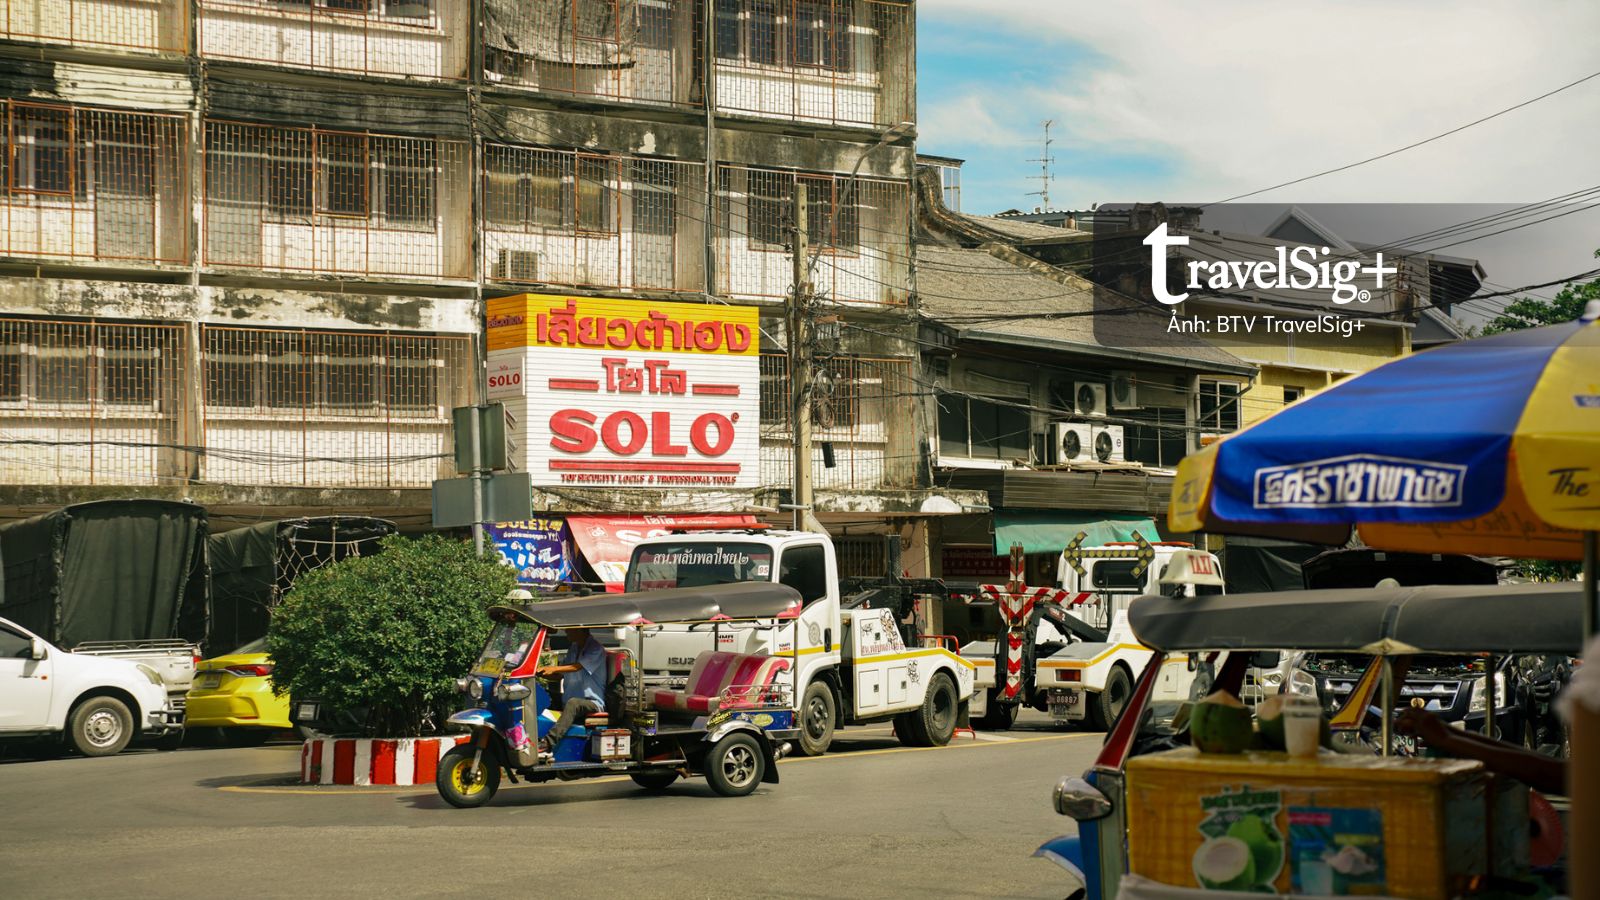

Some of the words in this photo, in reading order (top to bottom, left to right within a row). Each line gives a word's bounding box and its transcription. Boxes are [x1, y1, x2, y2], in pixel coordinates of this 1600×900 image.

[537, 300, 751, 350] เลี่ยวต้าเฮง
[489, 373, 521, 388] SOLO
[602, 358, 687, 393] โซโล
[577, 474, 616, 484] SECURITY
[618, 474, 644, 485] LOCKS
[656, 474, 711, 485] PROFESSIONAL
[712, 475, 737, 485] TOOLS
[1188, 555, 1213, 574] TAXI
